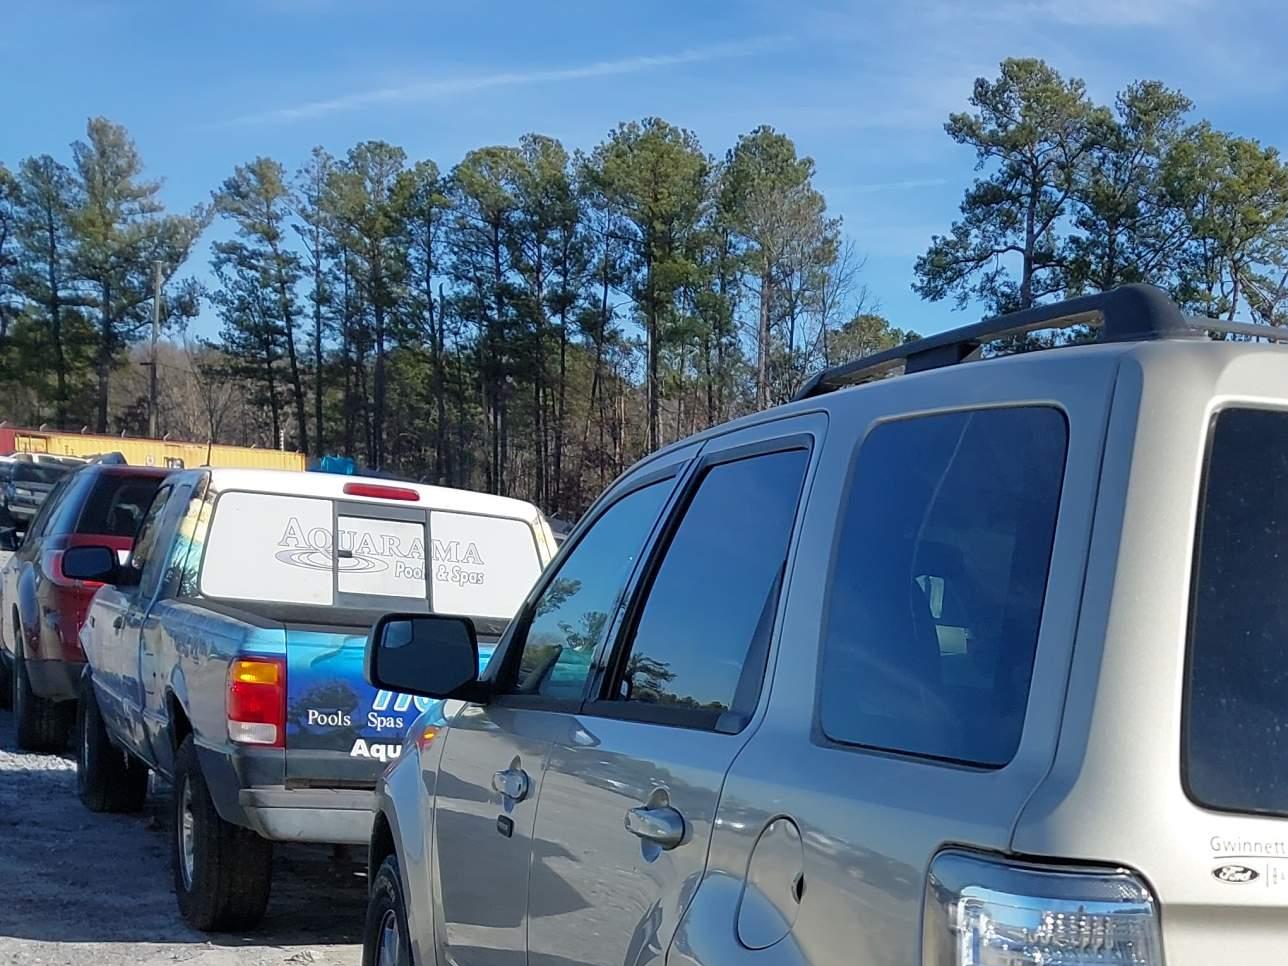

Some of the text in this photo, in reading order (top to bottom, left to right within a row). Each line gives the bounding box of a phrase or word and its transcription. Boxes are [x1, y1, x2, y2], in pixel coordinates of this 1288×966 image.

[278, 517, 484, 565] AQUARAMA
[395, 561, 484, 587] Pool & Spas
[307, 709, 404, 732] Pools Spas
[1209, 835, 1286, 855] Gwinnett
